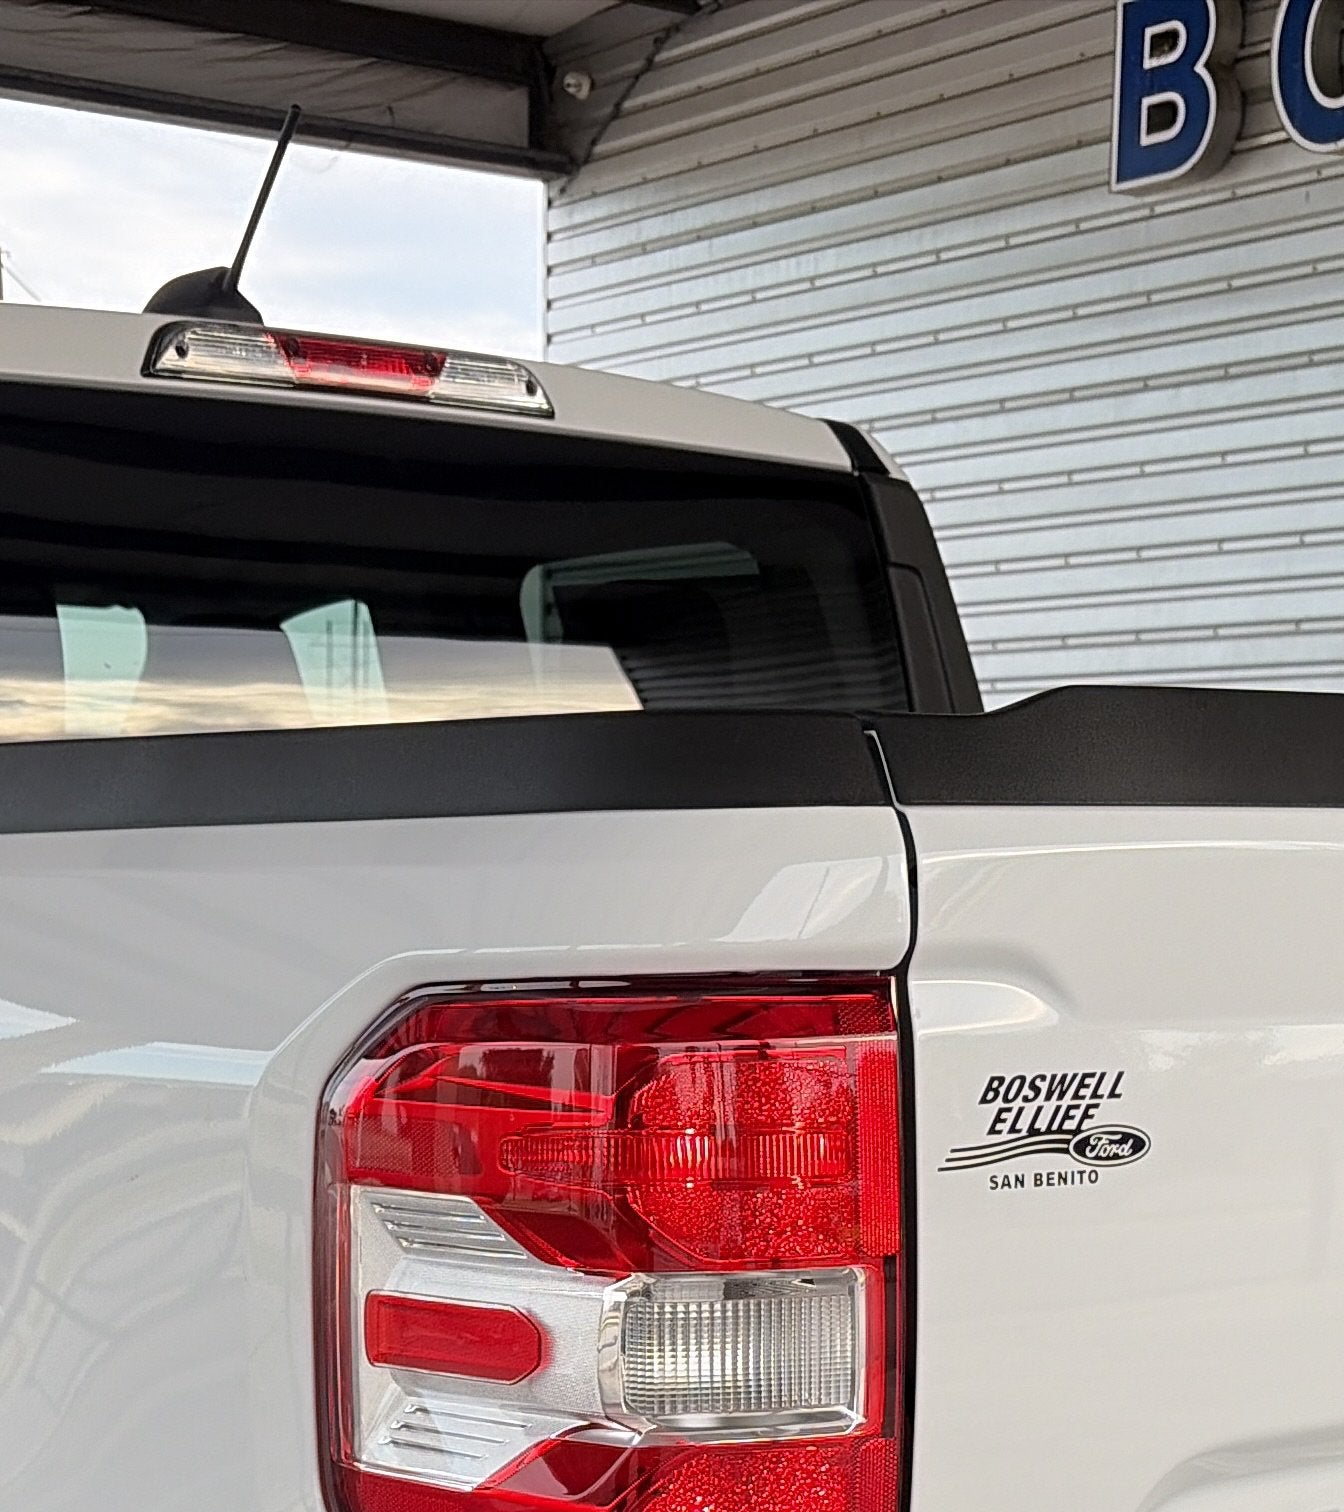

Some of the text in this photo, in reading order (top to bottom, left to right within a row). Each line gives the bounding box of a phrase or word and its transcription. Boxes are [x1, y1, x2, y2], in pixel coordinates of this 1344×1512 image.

[978, 1070, 1125, 1105] BOSWELL
[1085, 1133, 1133, 1159] Ford
[990, 1169, 1100, 1191] SAN BENITO
